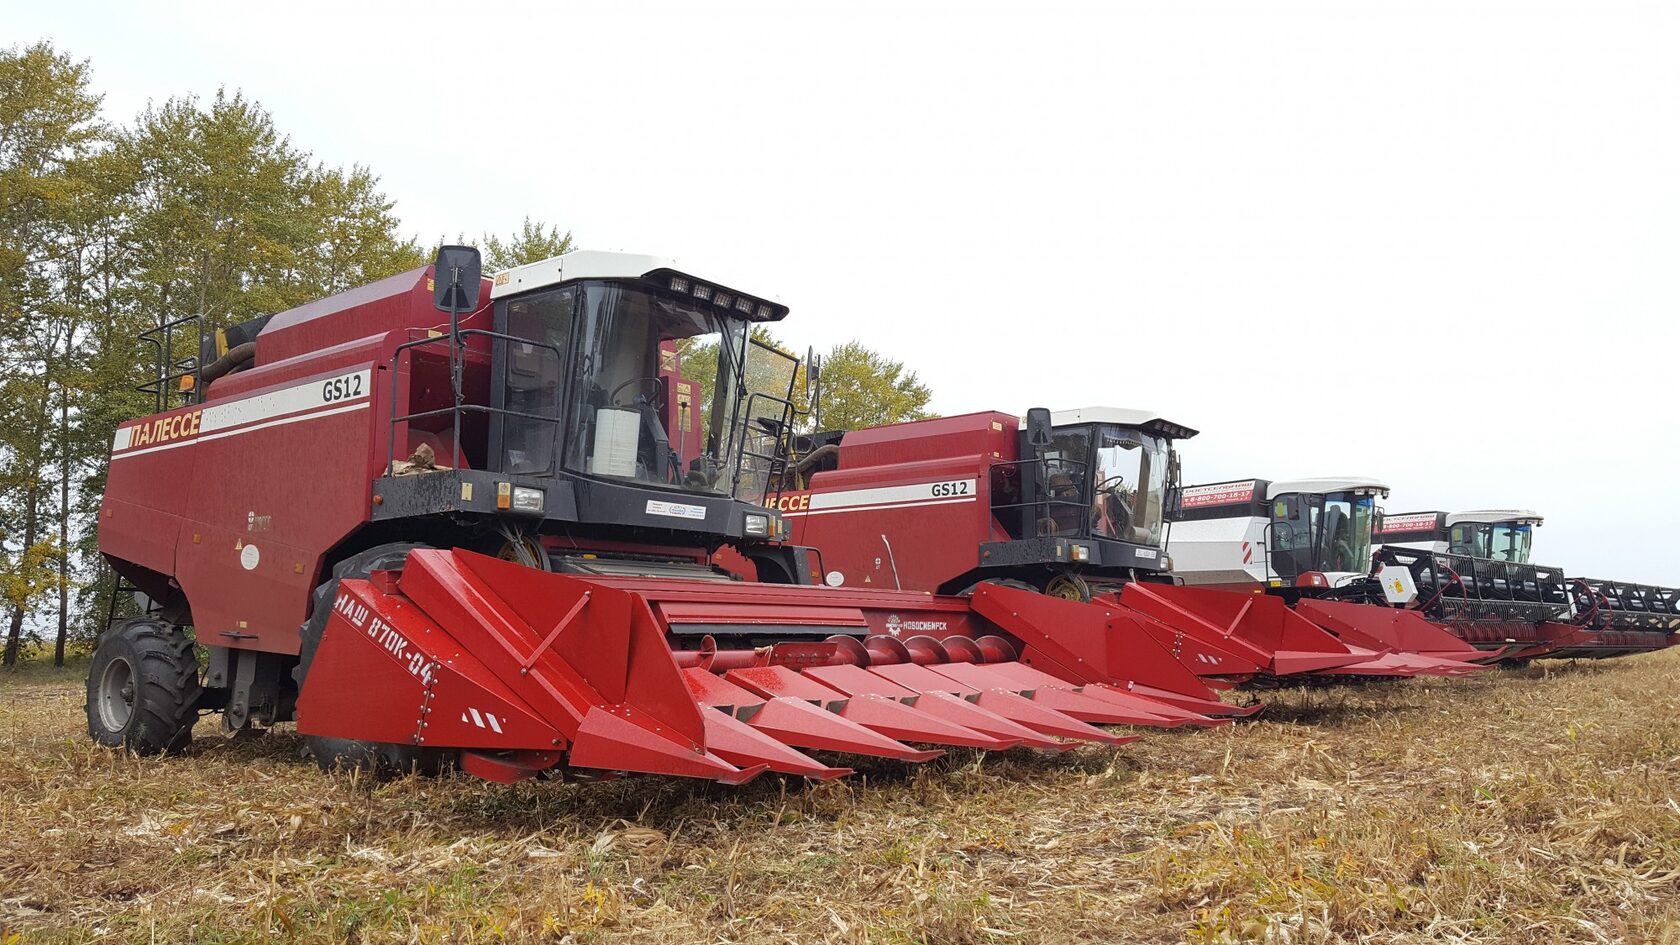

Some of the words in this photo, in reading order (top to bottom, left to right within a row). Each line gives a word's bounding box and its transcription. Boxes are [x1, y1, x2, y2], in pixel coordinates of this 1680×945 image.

[323, 373, 362, 402] GS12
[128, 410, 202, 448] ПАЛЕССЕ
[931, 481, 968, 497] GS12
[367, 617, 433, 686] 870К-04
